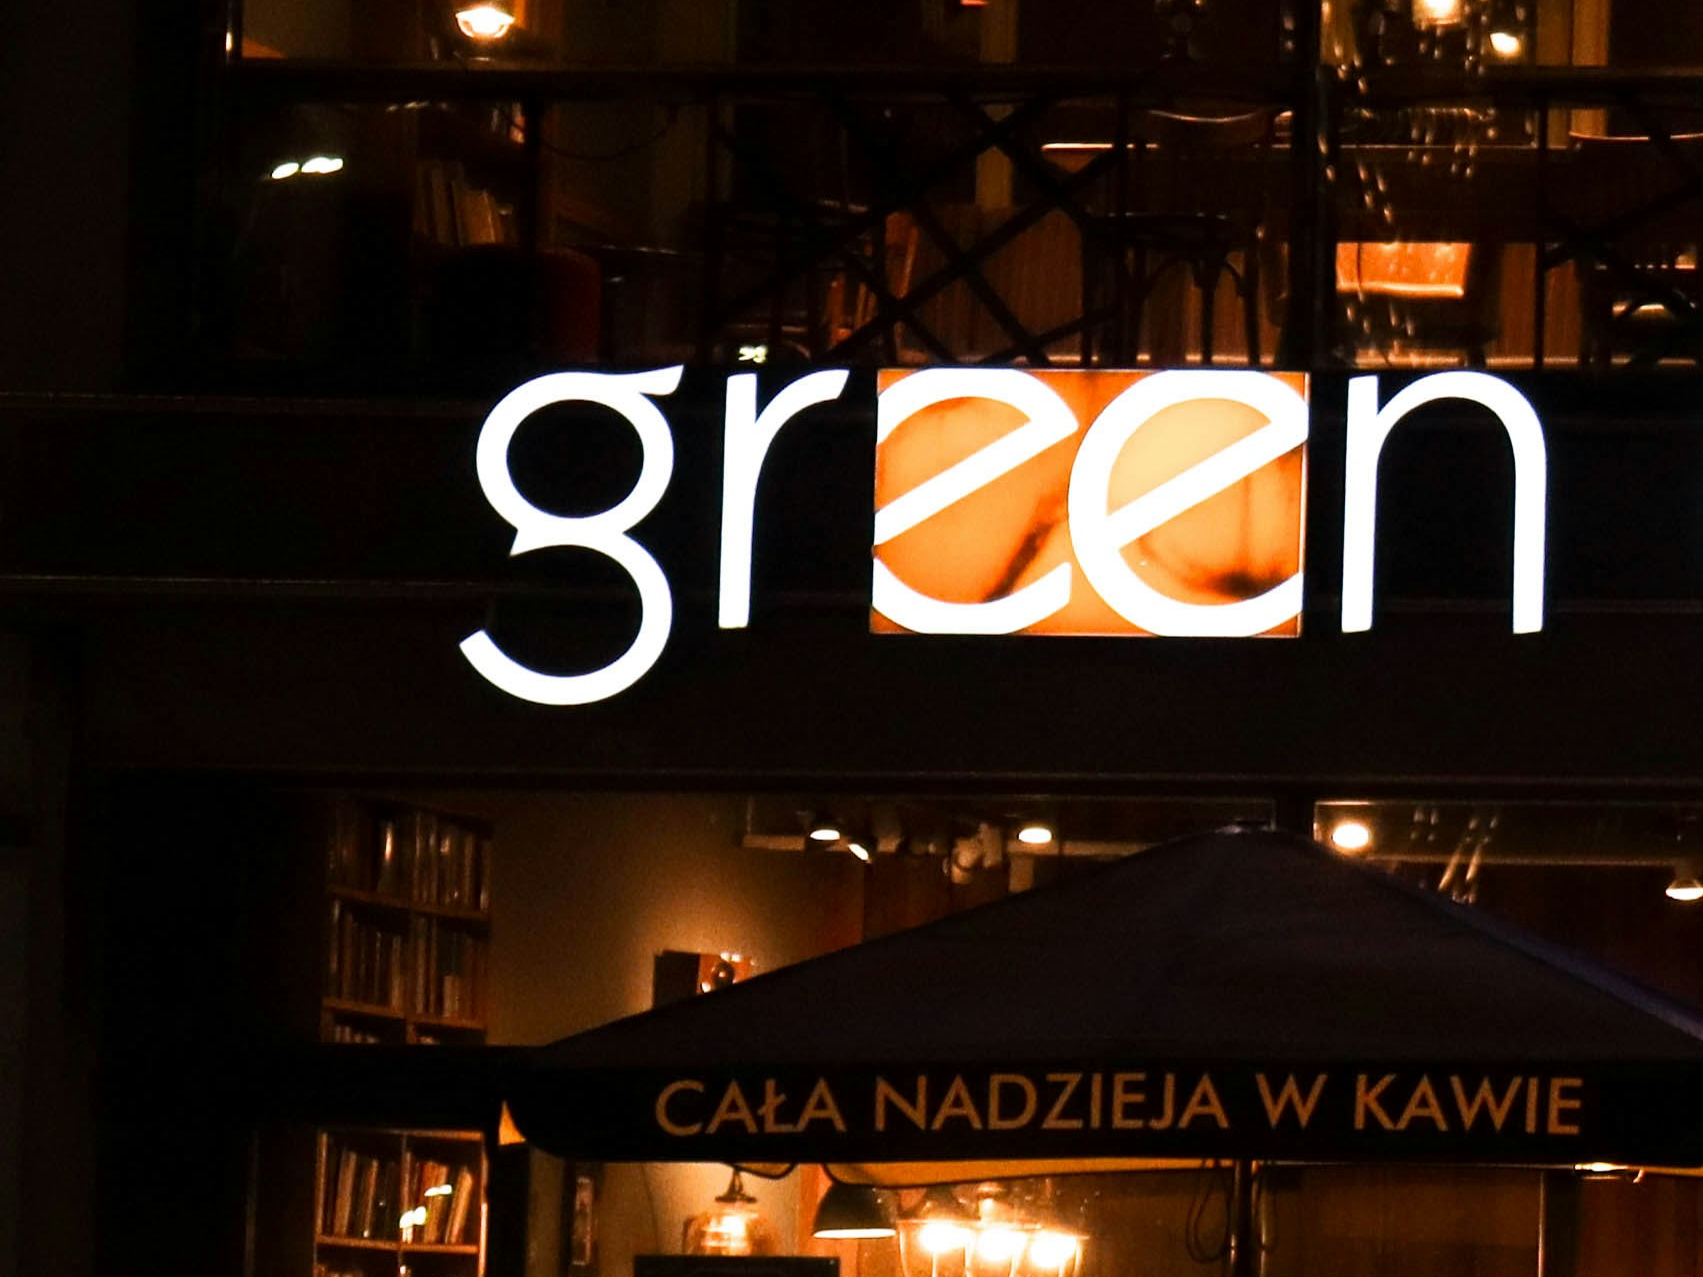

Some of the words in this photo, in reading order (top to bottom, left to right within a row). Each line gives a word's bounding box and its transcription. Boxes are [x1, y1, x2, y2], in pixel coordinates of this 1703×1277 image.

[460, 364, 1546, 705] green
[654, 1078, 849, 1137] CAŁA
[873, 1072, 1231, 1131] NADZIEJA
[1255, 1072, 1329, 1131] W
[1352, 1072, 1584, 1136] KAWIE
